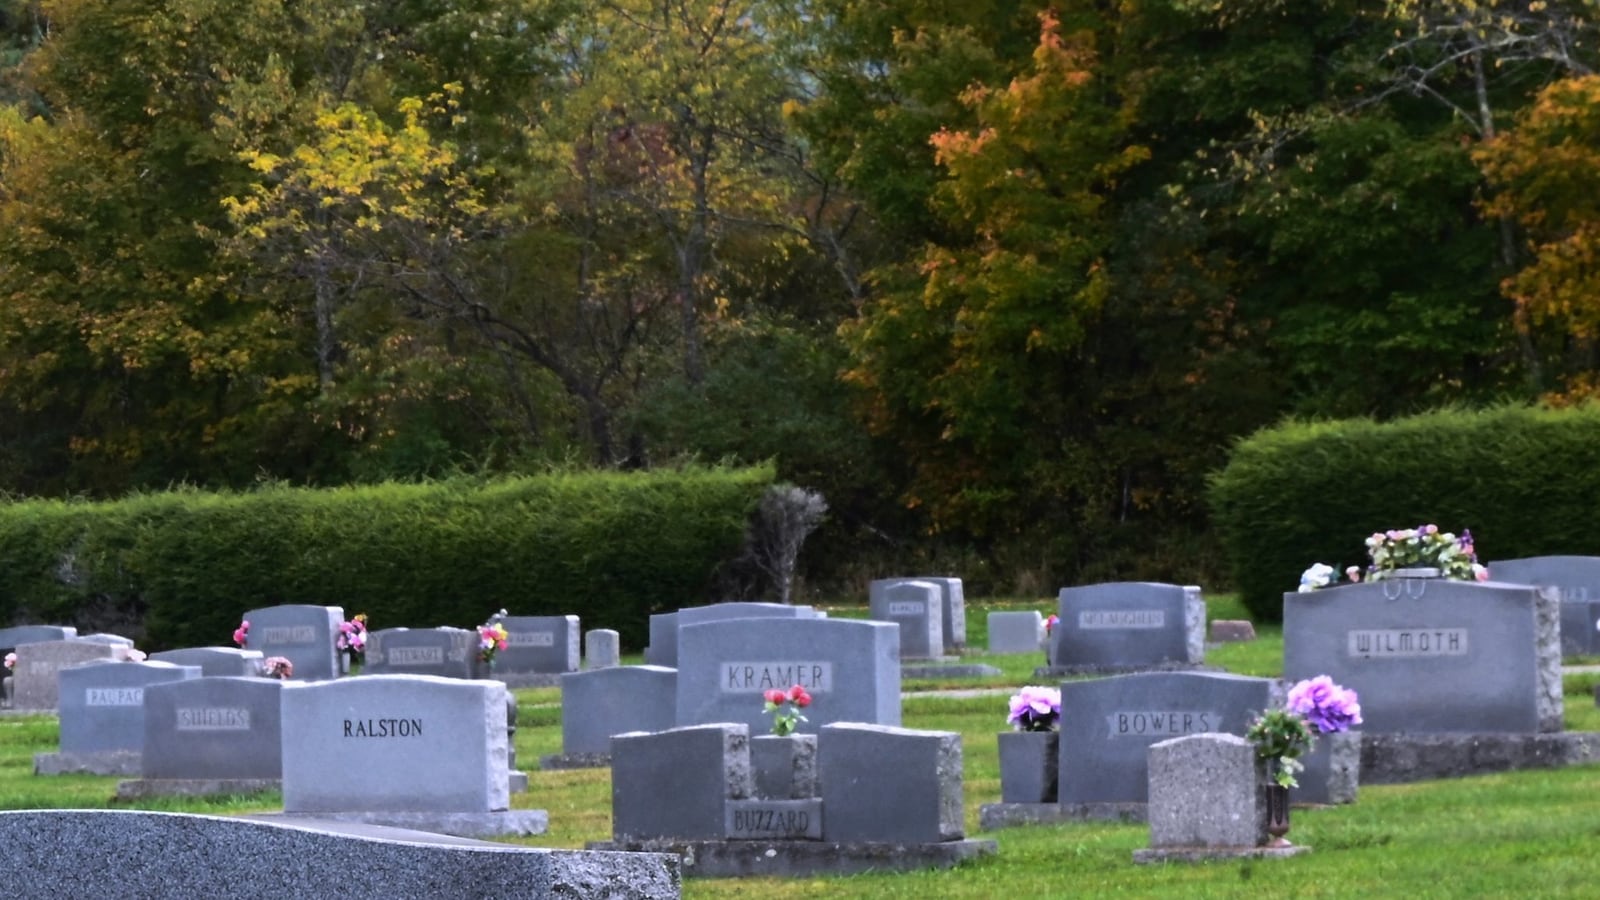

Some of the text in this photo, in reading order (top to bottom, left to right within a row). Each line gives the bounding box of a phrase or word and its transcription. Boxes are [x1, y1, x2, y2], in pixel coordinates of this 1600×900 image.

[1356, 631, 1460, 651] WILMOTH
[728, 665, 824, 689] KRAMER
[343, 719, 422, 737] RALSTON
[1118, 713, 1210, 733] BOWERS
[734, 810, 809, 831] BUZZARD
